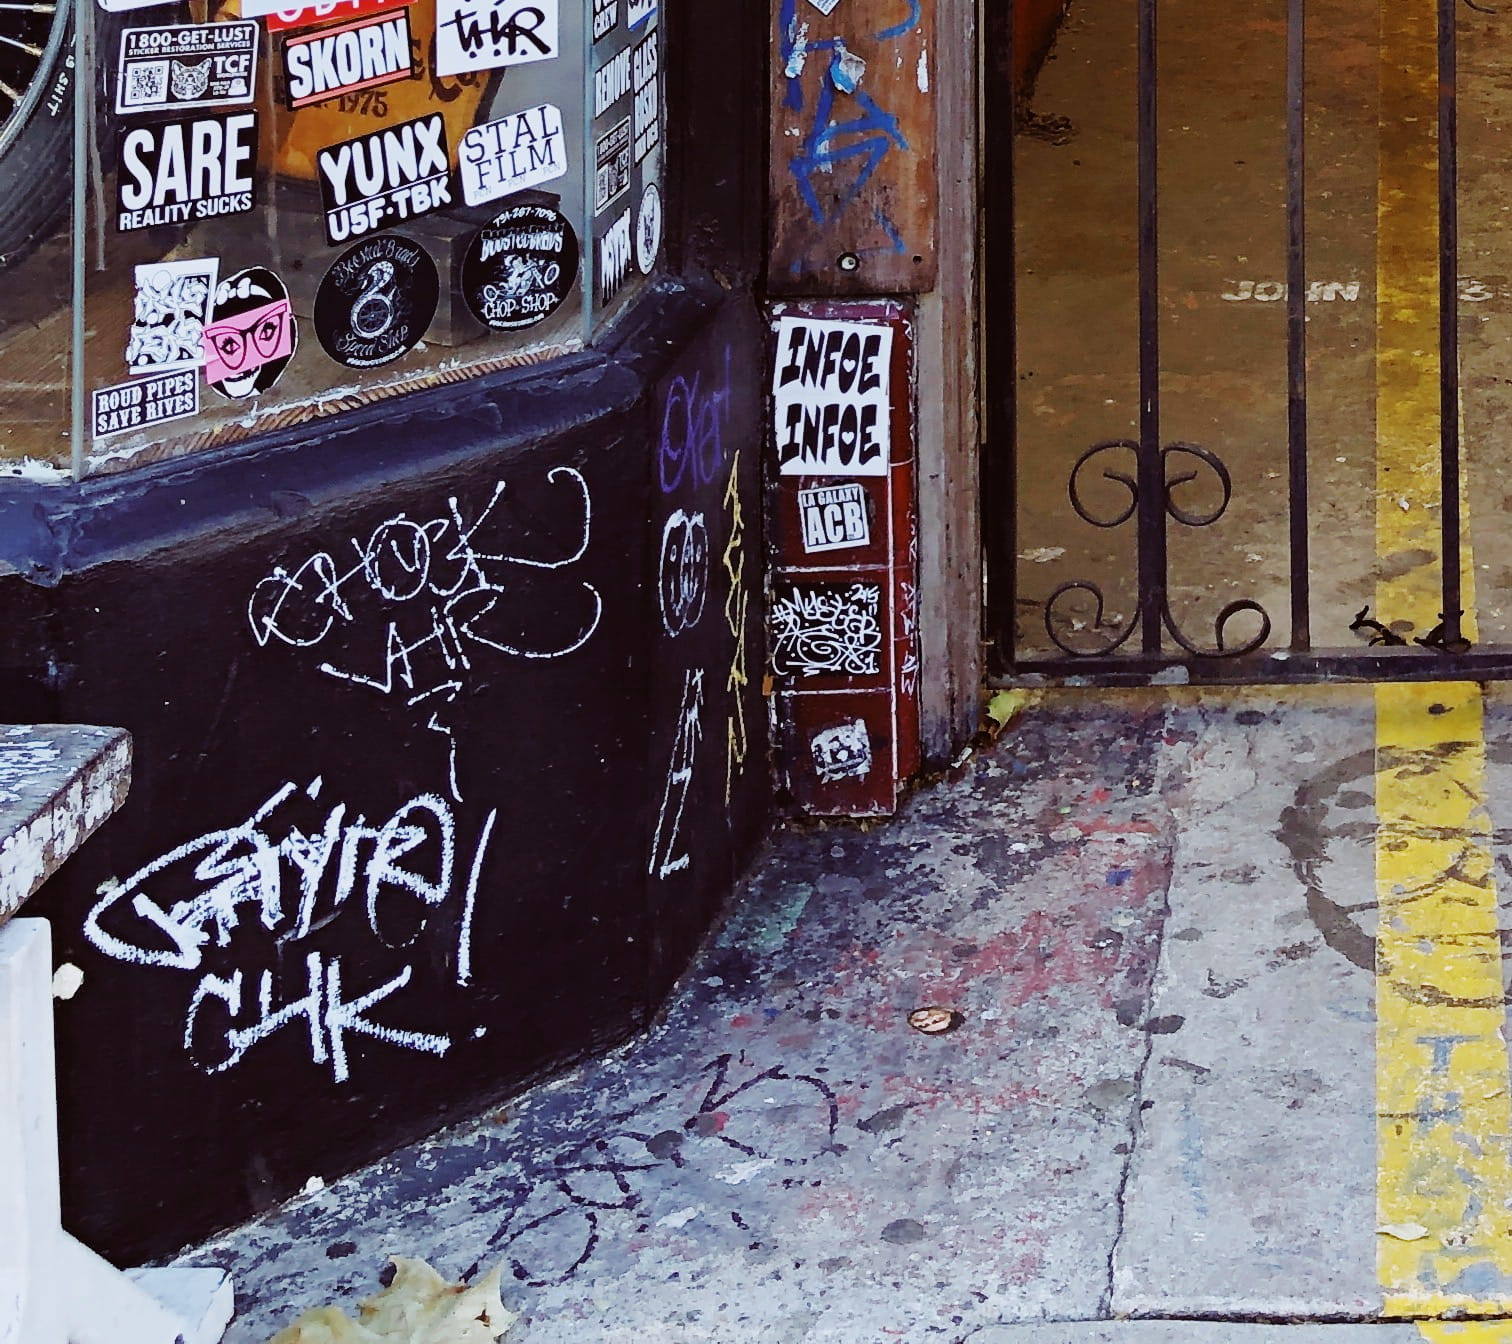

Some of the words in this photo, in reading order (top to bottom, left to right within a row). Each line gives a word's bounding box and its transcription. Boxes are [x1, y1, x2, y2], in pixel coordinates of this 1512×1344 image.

[130, 27, 252, 49] 1800-GET-LUST
[216, 55, 250, 74] TCF
[287, 18, 411, 99] SKORN
[338, 92, 388, 117] 1975
[465, 105, 559, 163] STAL
[121, 123, 253, 211] SARE
[320, 115, 447, 205] YUNX
[475, 138, 556, 190] FILM
[120, 200, 192, 230] REALITY
[196, 193, 251, 217] SUCKS
[1220, 281, 1359, 303] JOHN
[147, 374, 194, 400] PIPES
[802, 493, 815, 507] LA
[818, 488, 858, 505] GALAXY
[808, 502, 863, 545] ACB
